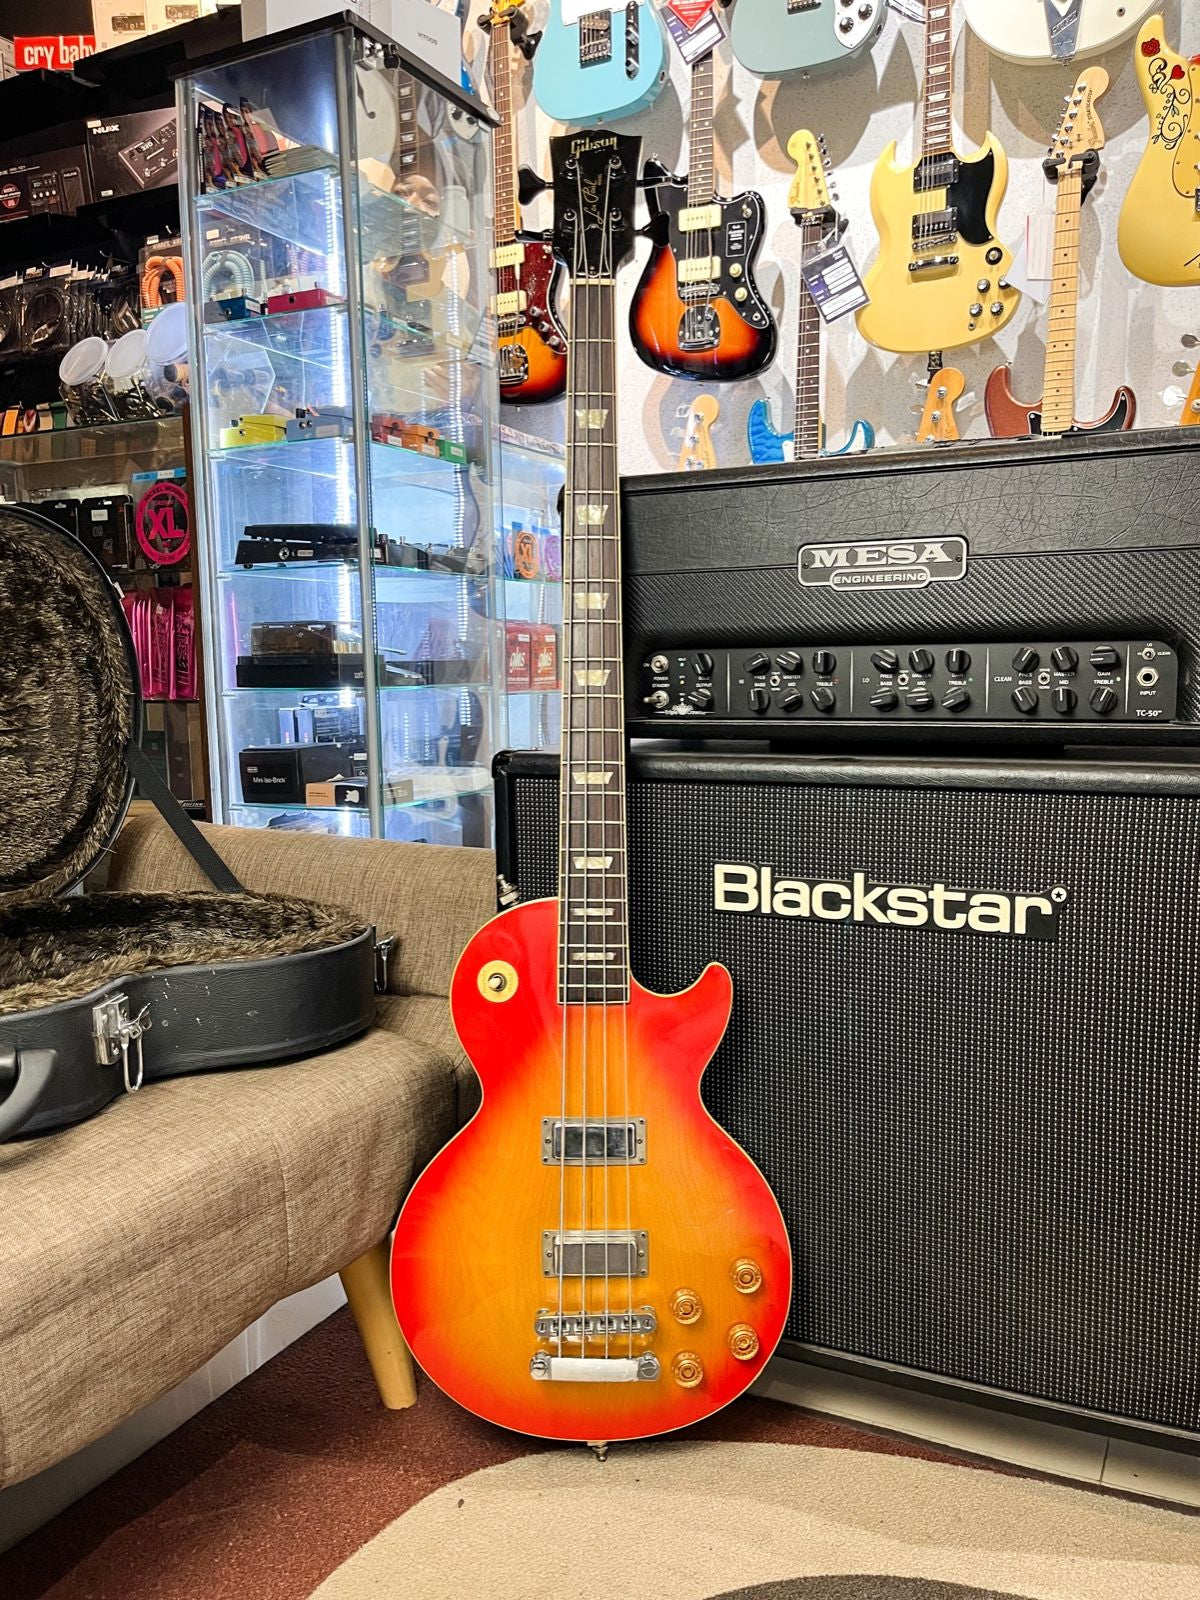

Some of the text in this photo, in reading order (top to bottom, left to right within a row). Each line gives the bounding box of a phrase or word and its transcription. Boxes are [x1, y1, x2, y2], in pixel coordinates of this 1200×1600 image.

[23, 45, 54, 70] cry
[92, 124, 120, 135] NUX
[571, 136, 618, 160] Gibson
[147, 507, 185, 540] XL
[810, 543, 953, 569] MESA
[833, 572, 927, 585] ENGINEERING
[714, 863, 1053, 935] Blackstar
